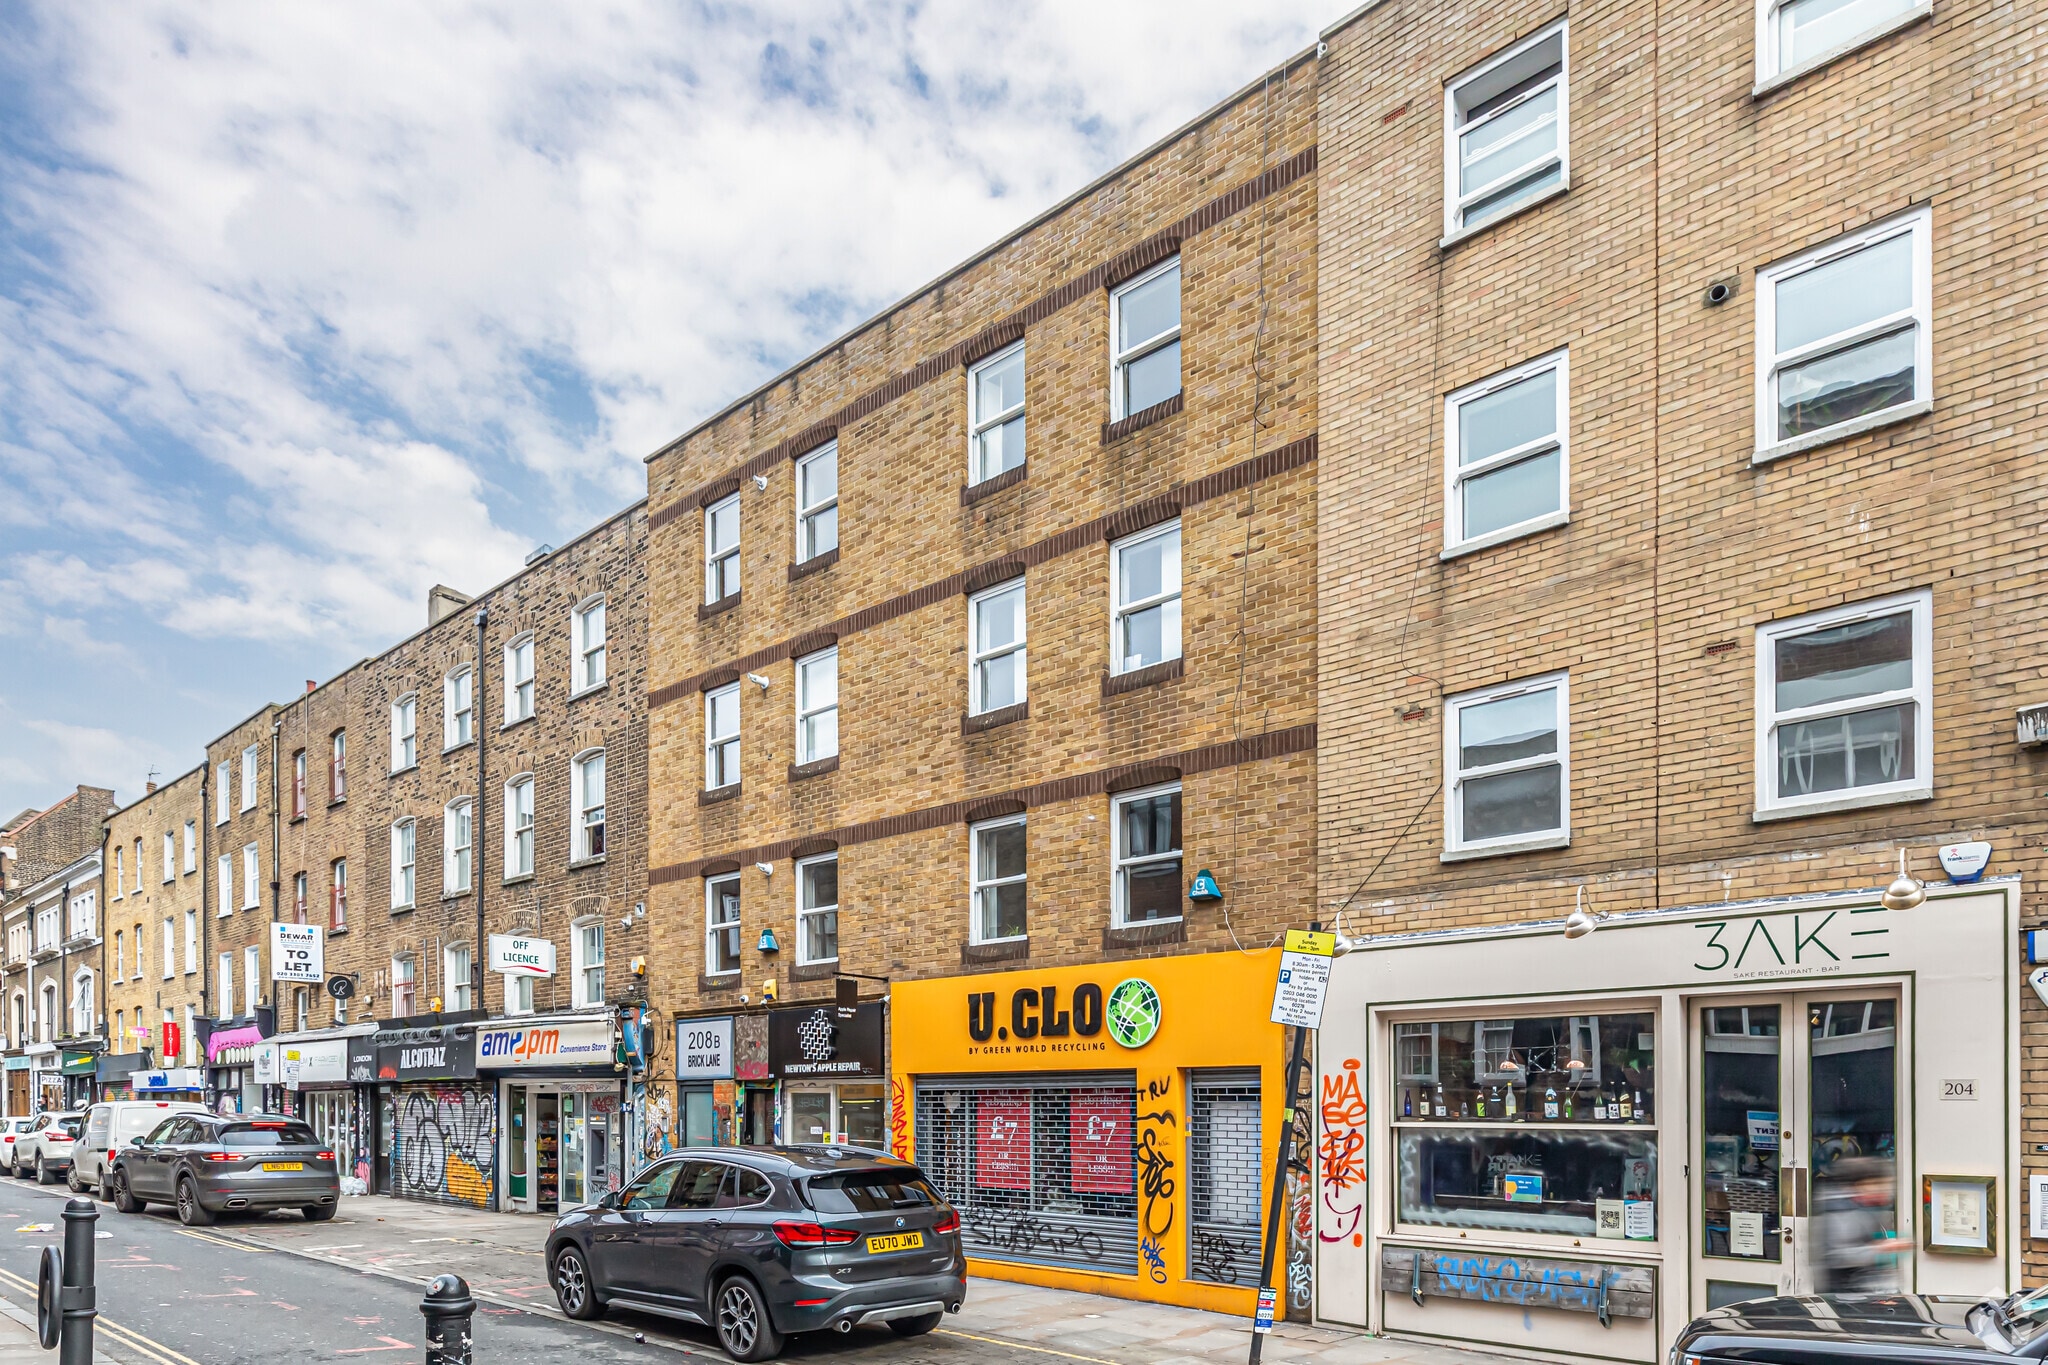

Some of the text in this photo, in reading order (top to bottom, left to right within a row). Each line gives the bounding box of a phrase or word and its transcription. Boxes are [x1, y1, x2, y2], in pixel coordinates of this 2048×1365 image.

[512, 940, 529, 950] OFF
[286, 950, 309, 960] TO
[503, 952, 539, 965] LICENCE
[284, 962, 312, 972] LET
[1733, 965, 1840, 979] SAKE RESTAURANT BAR
[1280, 971, 1290, 982] P
[967, 982, 1103, 1042] U.CLO
[560, 1043, 607, 1053] Convenience Store
[983, 1046, 1011, 1054] GREEN
[1015, 1045, 1046, 1053] WORLD
[1051, 1042, 1106, 1052] RECYCLING
[353, 1055, 373, 1063] LONDON
[688, 1054, 720, 1068] BRICK LANE
[785, 1061, 861, 1073] NEWTON'S APPLE REPAIR
[1944, 1082, 1974, 1095] 204
[990, 1115, 1018, 1145] £7
[1086, 1115, 1117, 1147] £7
[1095, 1155, 1108, 1163] OR
[871, 1234, 920, 1251] EU70 JWD
[836, 1267, 852, 1275] X1
